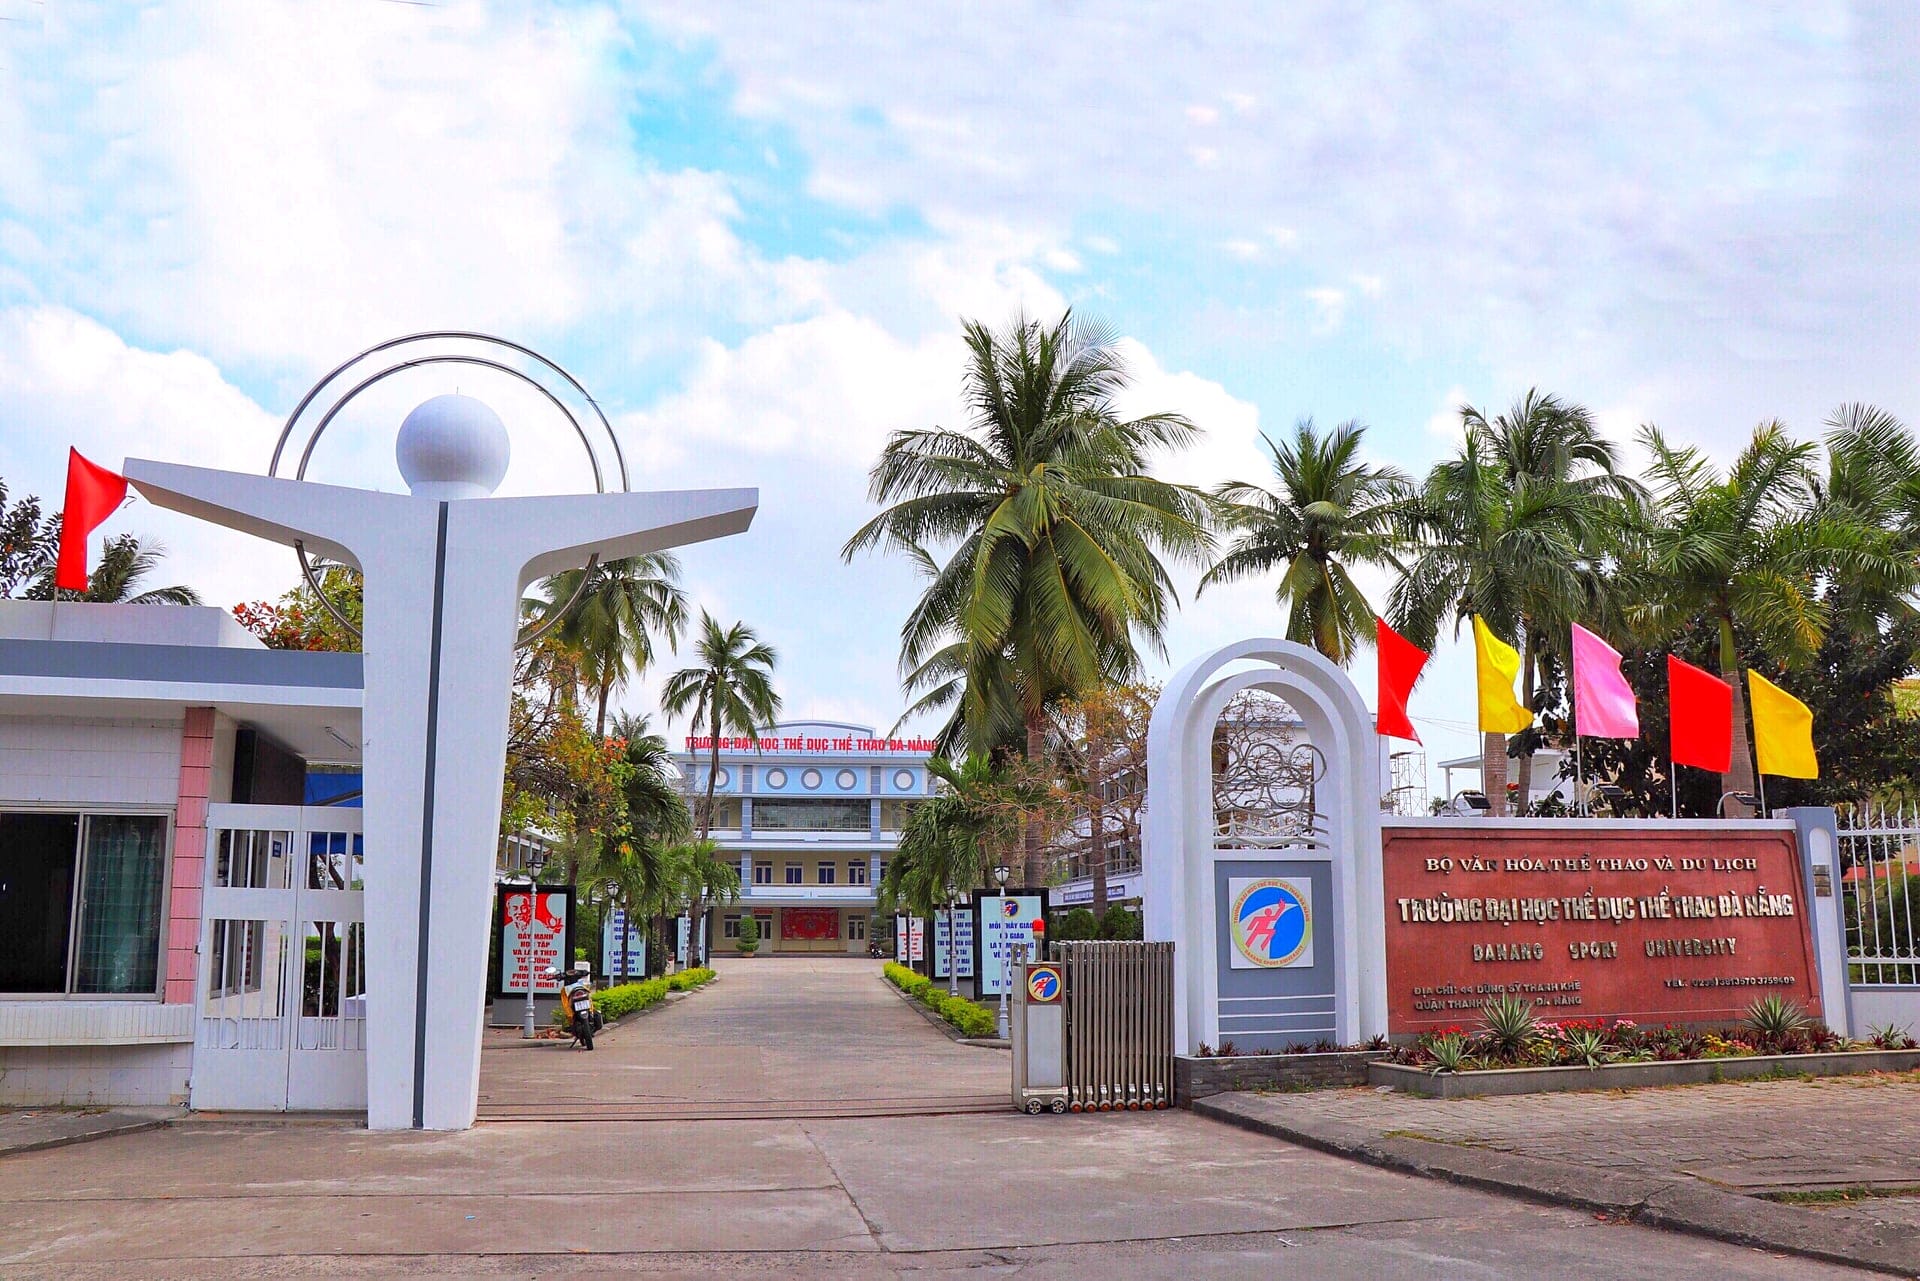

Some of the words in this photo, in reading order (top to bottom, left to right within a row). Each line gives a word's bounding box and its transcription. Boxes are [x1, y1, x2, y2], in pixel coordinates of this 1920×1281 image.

[807, 738, 829, 752] DỤC
[857, 739, 885, 751] THAO
[1425, 857, 1454, 875] BỘ
[1458, 855, 1496, 871] VĂN
[1597, 858, 1648, 871] THAO
[1653, 855, 1675, 871] VÀ
[1681, 858, 1707, 871] DU
[1712, 858, 1757, 873] LỊCH
[1398, 891, 1482, 922] TRƯỜNG
[1485, 898, 1518, 926] ĐẠI
[1520, 897, 1559, 925] HỌC
[1561, 885, 1597, 920] THỂ
[1598, 897, 1635, 924] DỤC
[1638, 885, 1671, 919] THỂ
[1674, 896, 1717, 918] THAO
[1718, 890, 1743, 917] ĐÀ
[1472, 943, 1544, 961] DANANG
[1569, 941, 1618, 960] SPORT
[1644, 937, 1737, 957] UNIVERSITY
[1523, 982, 1558, 992] THANH
[1415, 997, 1445, 1012] QUẬN
[1448, 998, 1483, 1010] THANH
